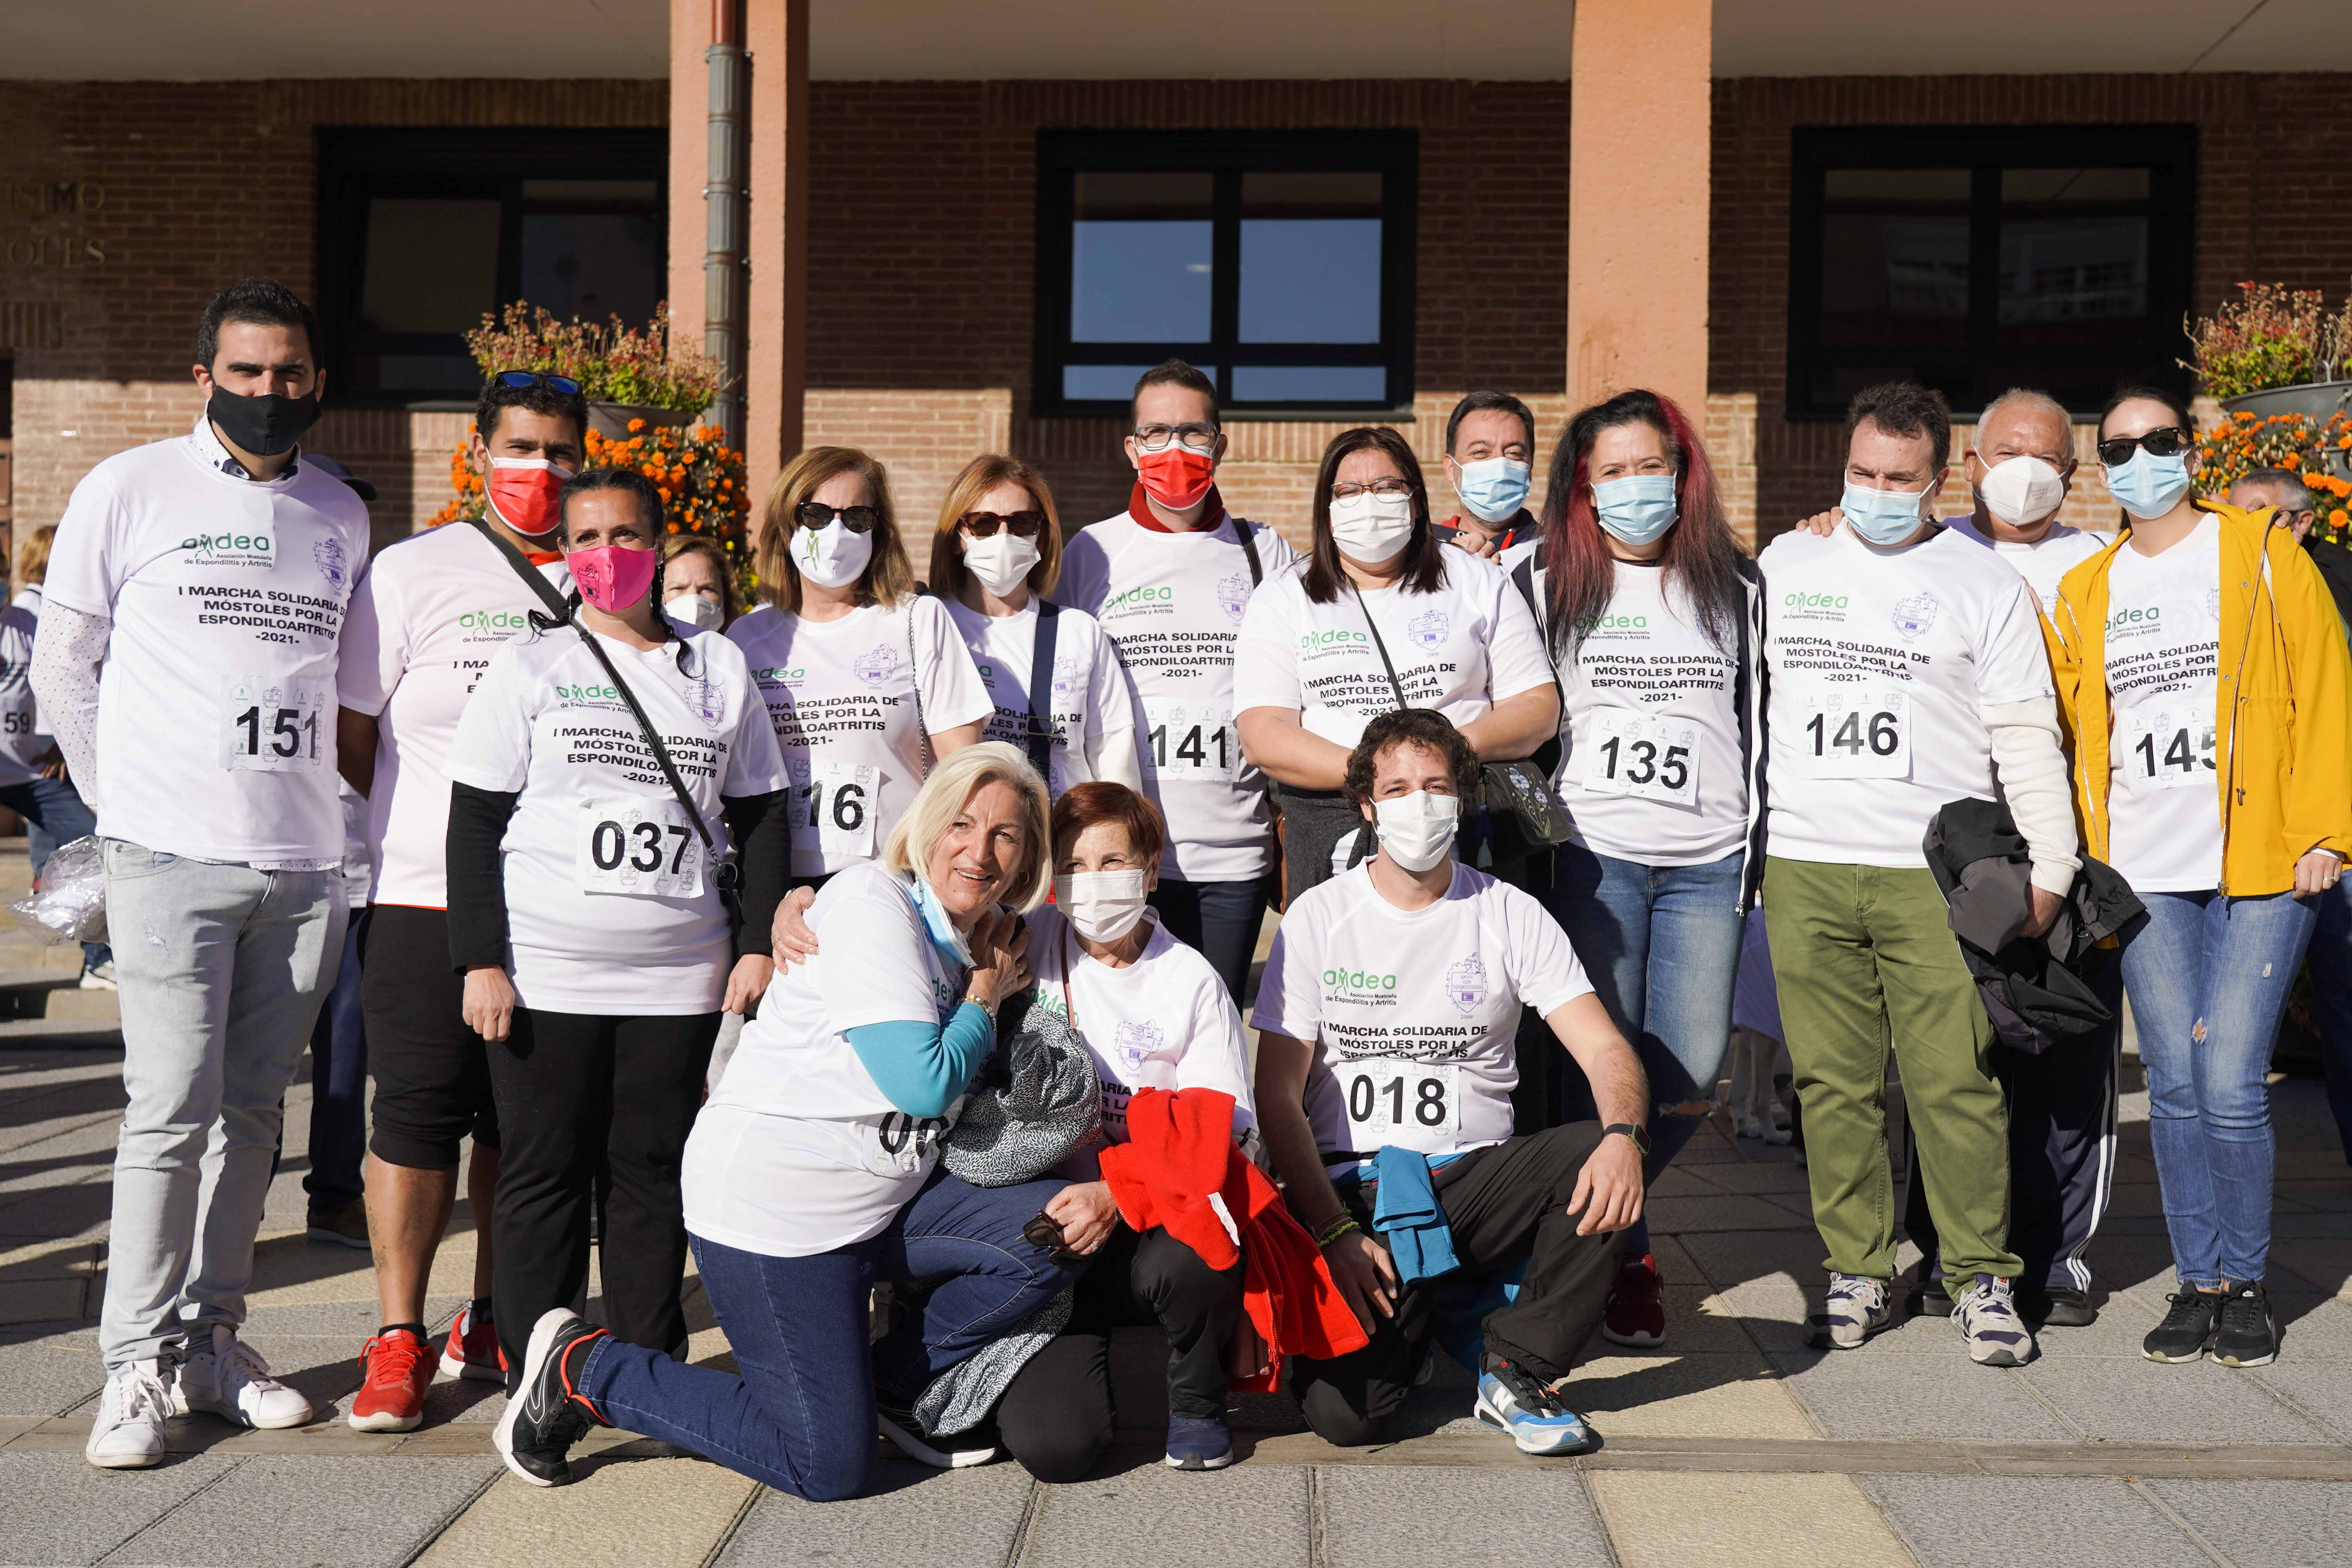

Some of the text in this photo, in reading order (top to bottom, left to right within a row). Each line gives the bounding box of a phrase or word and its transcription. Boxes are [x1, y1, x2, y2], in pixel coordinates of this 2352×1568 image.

[179, 586, 182, 595] I
[189, 586, 263, 599] MARCHA
[268, 591, 338, 612] SOLIDARIA
[204, 599, 337, 627] MÓSTOLES POR LA
[459, 611, 529, 635] amde
[1115, 610, 1147, 619] Espondilitis
[199, 615, 336, 640] ESPONDILOARTRITIS
[256, 632, 299, 644] -2021-
[1111, 633, 1237, 646] MARCHA SOLIDARIA
[1121, 644, 1192, 657] MÓSTOLES
[1778, 637, 1831, 647] MARCHA
[1837, 642, 1906, 659] SOLIDARIA
[1911, 653, 1930, 664] DE
[1308, 650, 1340, 661] Espondilitis
[1583, 655, 1645, 664] MARCHA
[1650, 656, 1722, 665] SOLIDARIA
[1786, 647, 1907, 670] MÓSTOLES POR LA
[2105, 642, 2219, 671] MARCHA SOLIDAR
[1308, 674, 1363, 689] MARCHA
[1368, 664, 1436, 683] SOLDARIA
[1595, 665, 1672, 676] MÓSTOLES
[1711, 669, 1723, 677] LA
[2112, 655, 2215, 681] MÓSTOLES POR
[556, 684, 618, 703] amde
[1320, 677, 1438, 699] MÓSTOLES OR LA
[1592, 679, 1724, 690] ESPONDILOARTRITIS
[2149, 683, 2192, 694] -2021-
[797, 696, 899, 708] SOLIDARIA DE
[1640, 693, 1682, 702] -2021-
[770, 708, 881, 722] TOLES POR LA
[1071, 714, 1082, 722] DE
[237, 706, 316, 759] 151
[773, 721, 885, 735] NDILOARTRITIS
[1806, 711, 1898, 757] 146
[554, 728, 727, 753] I MARCHA SLIDARIA DE
[573, 739, 717, 764] MÓSTOLE POR LA
[787, 736, 833, 746] -2021-
[1148, 725, 1226, 768] 141
[1600, 736, 1688, 789] 135
[2136, 727, 2216, 777] 145
[802, 780, 864, 830] 16
[592, 820, 692, 875] 037
[1335, 996, 1368, 1005] Espondilitis
[1329, 1023, 1388, 1036] MARCHA
[1393, 1026, 1467, 1036] SOLIDARIA
[1471, 1025, 1488, 1035] DE
[1339, 1038, 1414, 1049] MÓSTOLES
[1419, 1040, 1448, 1049] POR
[1350, 1074, 1446, 1126] 018
